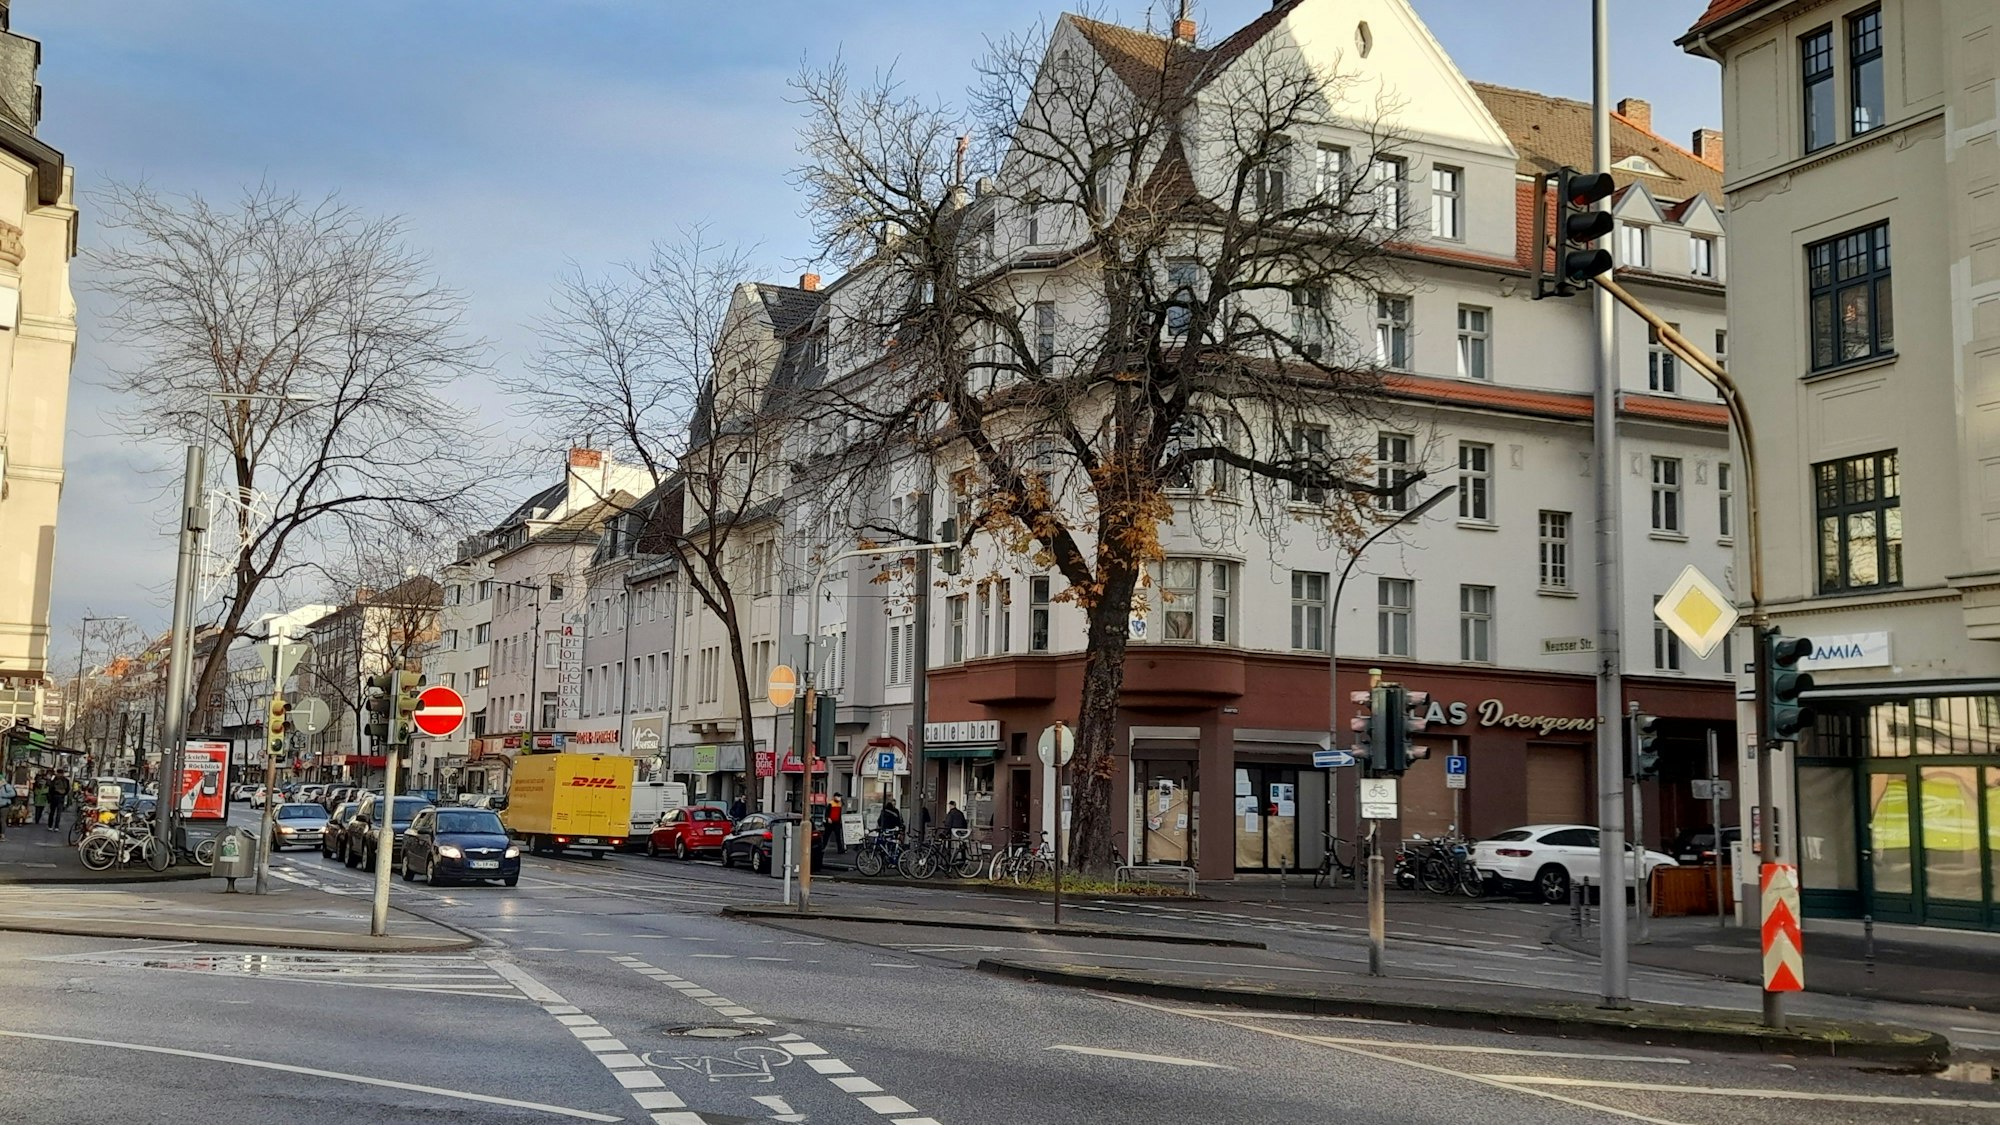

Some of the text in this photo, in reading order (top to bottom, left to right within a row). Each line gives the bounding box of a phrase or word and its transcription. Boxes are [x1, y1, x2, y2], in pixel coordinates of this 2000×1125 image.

[1545, 638, 1594, 652] Neusser Str.
[1409, 702, 1468, 726] LAS
[571, 777, 617, 789] DHL
